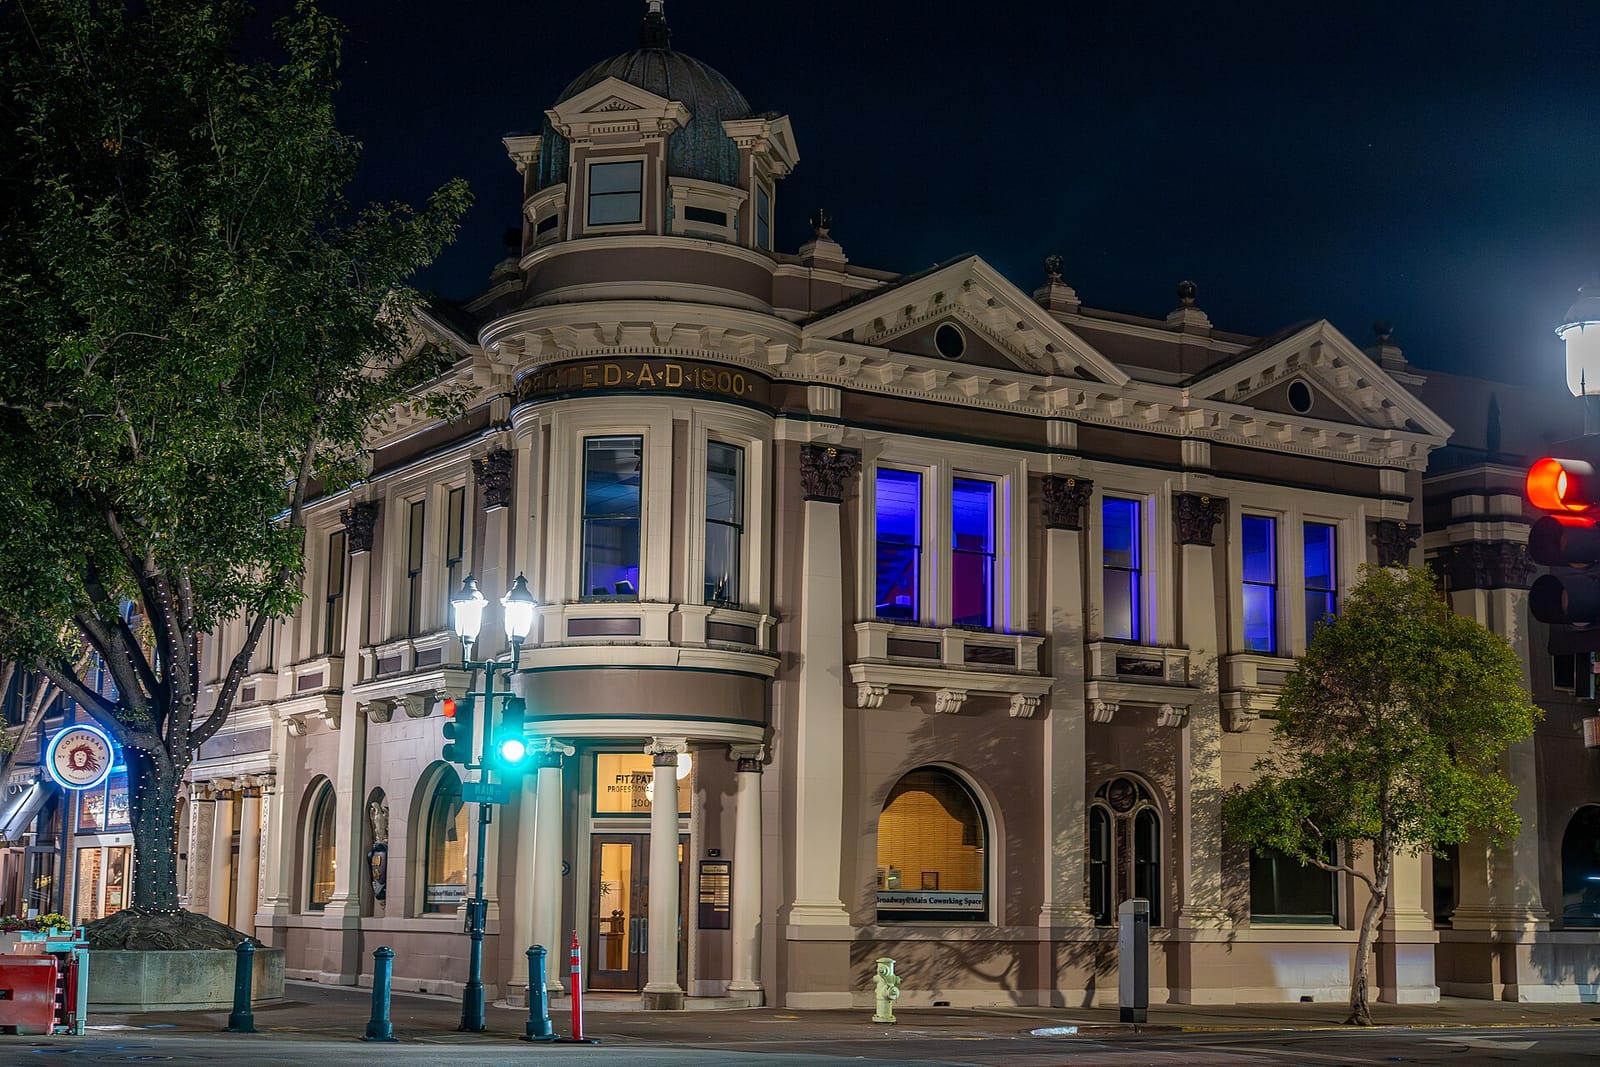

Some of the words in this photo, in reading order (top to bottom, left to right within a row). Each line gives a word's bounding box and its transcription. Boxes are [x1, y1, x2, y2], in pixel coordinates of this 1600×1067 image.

[636, 363, 656, 387] A
[665, 364, 683, 388] D
[694, 368, 746, 396] 1900
[61, 735, 103, 750] COFFEEBAR
[615, 774, 653, 784] FITZPAT
[474, 784, 494, 795] MAIN
[607, 785, 653, 793] PROFESSIONAL
[928, 897, 963, 907] Coworking
[964, 898, 982, 907] Space
